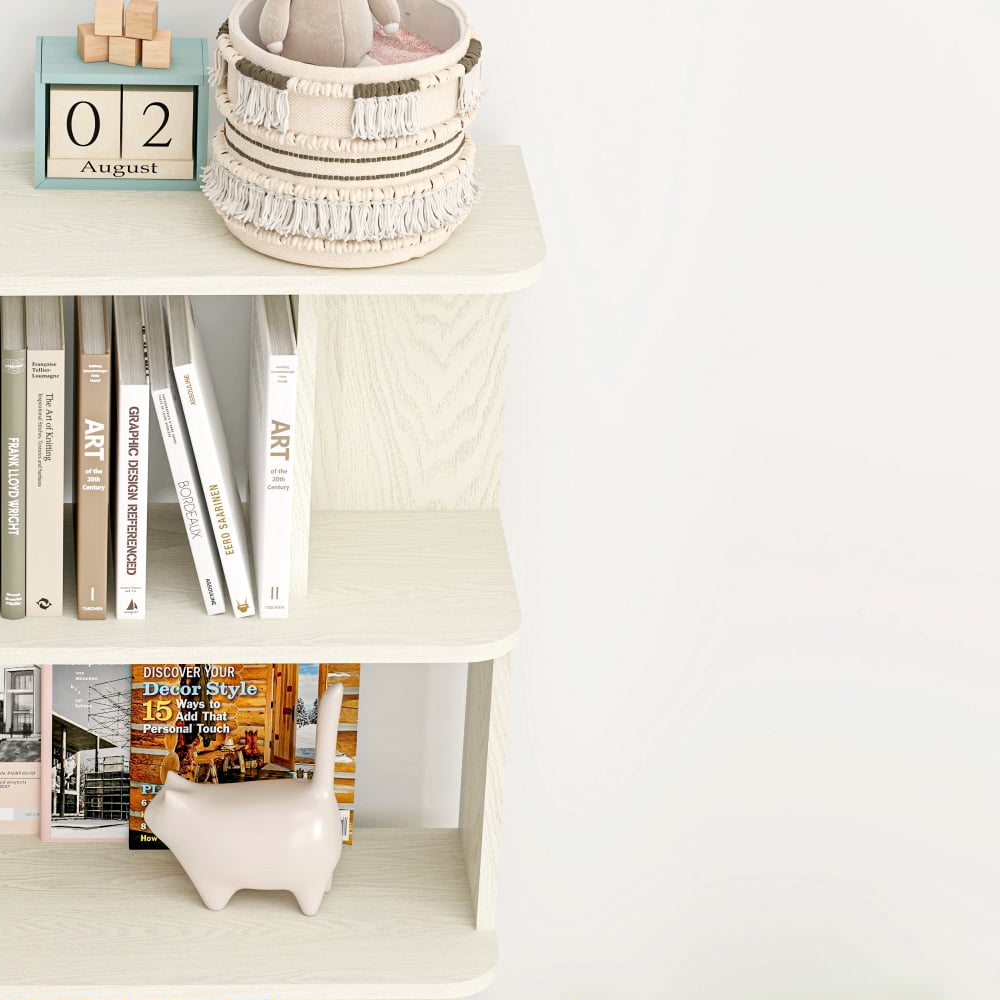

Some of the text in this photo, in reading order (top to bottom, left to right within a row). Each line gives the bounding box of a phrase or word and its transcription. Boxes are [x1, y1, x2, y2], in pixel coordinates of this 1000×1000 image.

[80, 161, 158, 177] August
[183, 374, 197, 406] ASSOULINE
[43, 393, 54, 461] The Art of Knitting
[84, 418, 105, 461] ART
[127, 406, 140, 456] GRAPHIC
[269, 419, 291, 461] ART
[7, 437, 20, 535] FRANK LLOYD WRIGHT
[127, 460, 139, 500] DESIGN
[178, 480, 202, 540] BORDEAUX
[206, 484, 235, 556] EERO SAARINEN
[126, 504, 138, 576] REFERENCED
[143, 666, 235, 678] DISCOVER YOUR
[142, 681, 258, 700] Decor Style
[176, 699, 221, 710] Ways to
[142, 700, 172, 722] 15
[143, 723, 230, 734] Personal Touch
[175, 711, 227, 721] Add That
[140, 834, 158, 842] How
